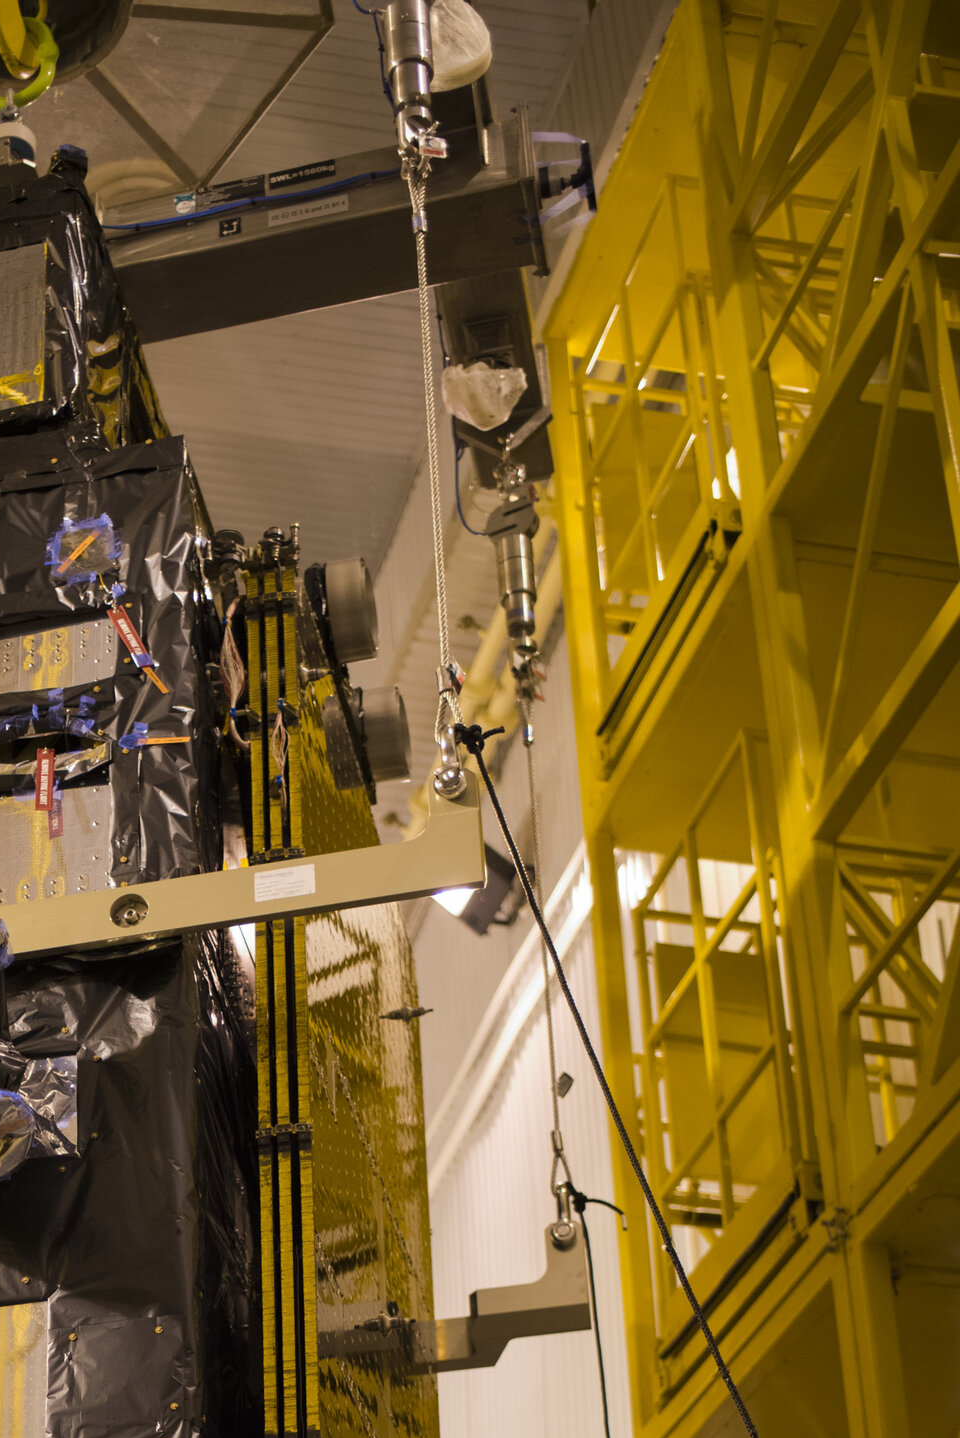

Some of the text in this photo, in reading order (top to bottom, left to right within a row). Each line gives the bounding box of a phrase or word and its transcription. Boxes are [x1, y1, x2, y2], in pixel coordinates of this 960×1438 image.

[40, 759, 50, 805] REMOVE BEFORE FLIGHT
